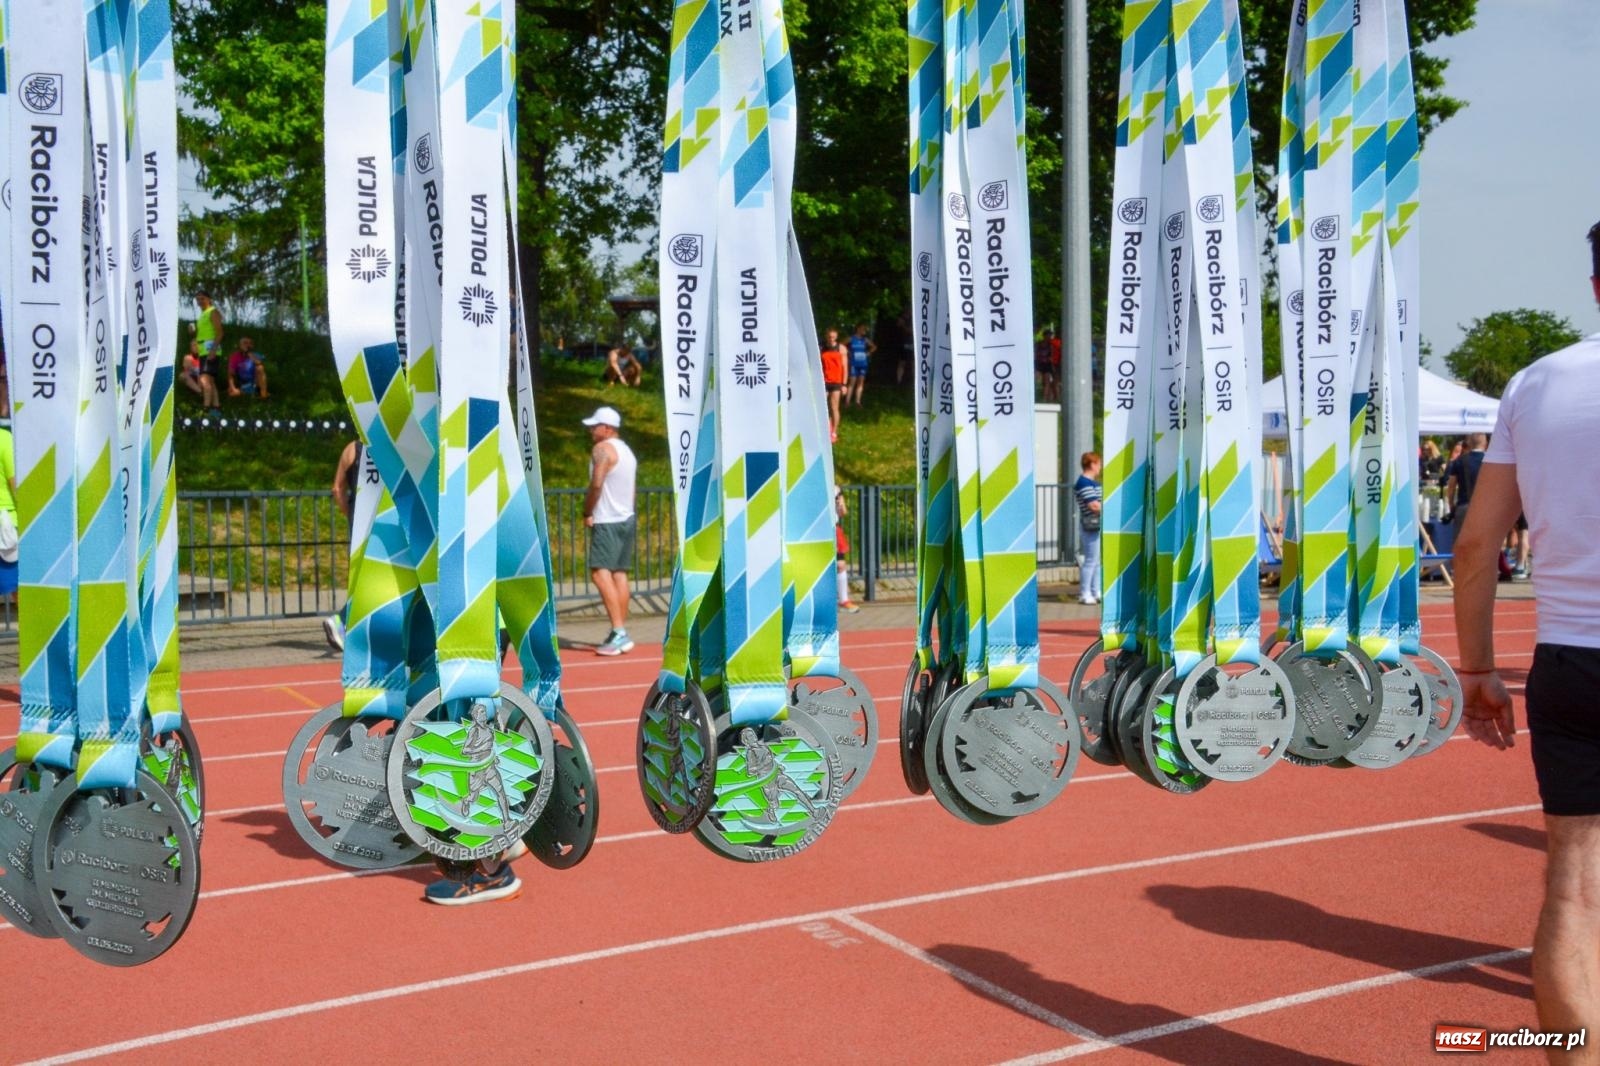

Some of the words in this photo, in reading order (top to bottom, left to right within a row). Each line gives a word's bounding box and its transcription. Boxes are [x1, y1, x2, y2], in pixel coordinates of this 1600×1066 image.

[31, 125, 58, 283] Racibórz
[357, 155, 377, 237] POLICJA
[471, 193, 488, 276] POLICJA
[742, 267, 758, 343] POLICJA
[986, 217, 1010, 333] Racibórz
[1120, 231, 1143, 334] Racibórz
[1170, 246, 1184, 353] Racibórz
[1205, 229, 1226, 335] Racibórz
[1317, 247, 1337, 345] Racibórz
[32, 324, 56, 399] OSiR
[95, 319, 107, 393] OSiR
[124, 280, 151, 430] Racibórz
[676, 274, 698, 398] Racibórz
[920, 288, 933, 400] Racibórz
[993, 361, 1013, 416] OSiR
[1117, 360, 1135, 411] OSiR
[1215, 361, 1232, 412] OSiR
[1317, 368, 1334, 417] OSiR
[521, 406, 533, 473] OSiR
[678, 429, 691, 491] OSiR
[921, 426, 930, 481] OSiR
[1366, 458, 1381, 504] OSiR
[332, 768, 386, 792] Racibórz
[423, 836, 455, 859] XVII
[459, 846, 494, 860] BIEG
